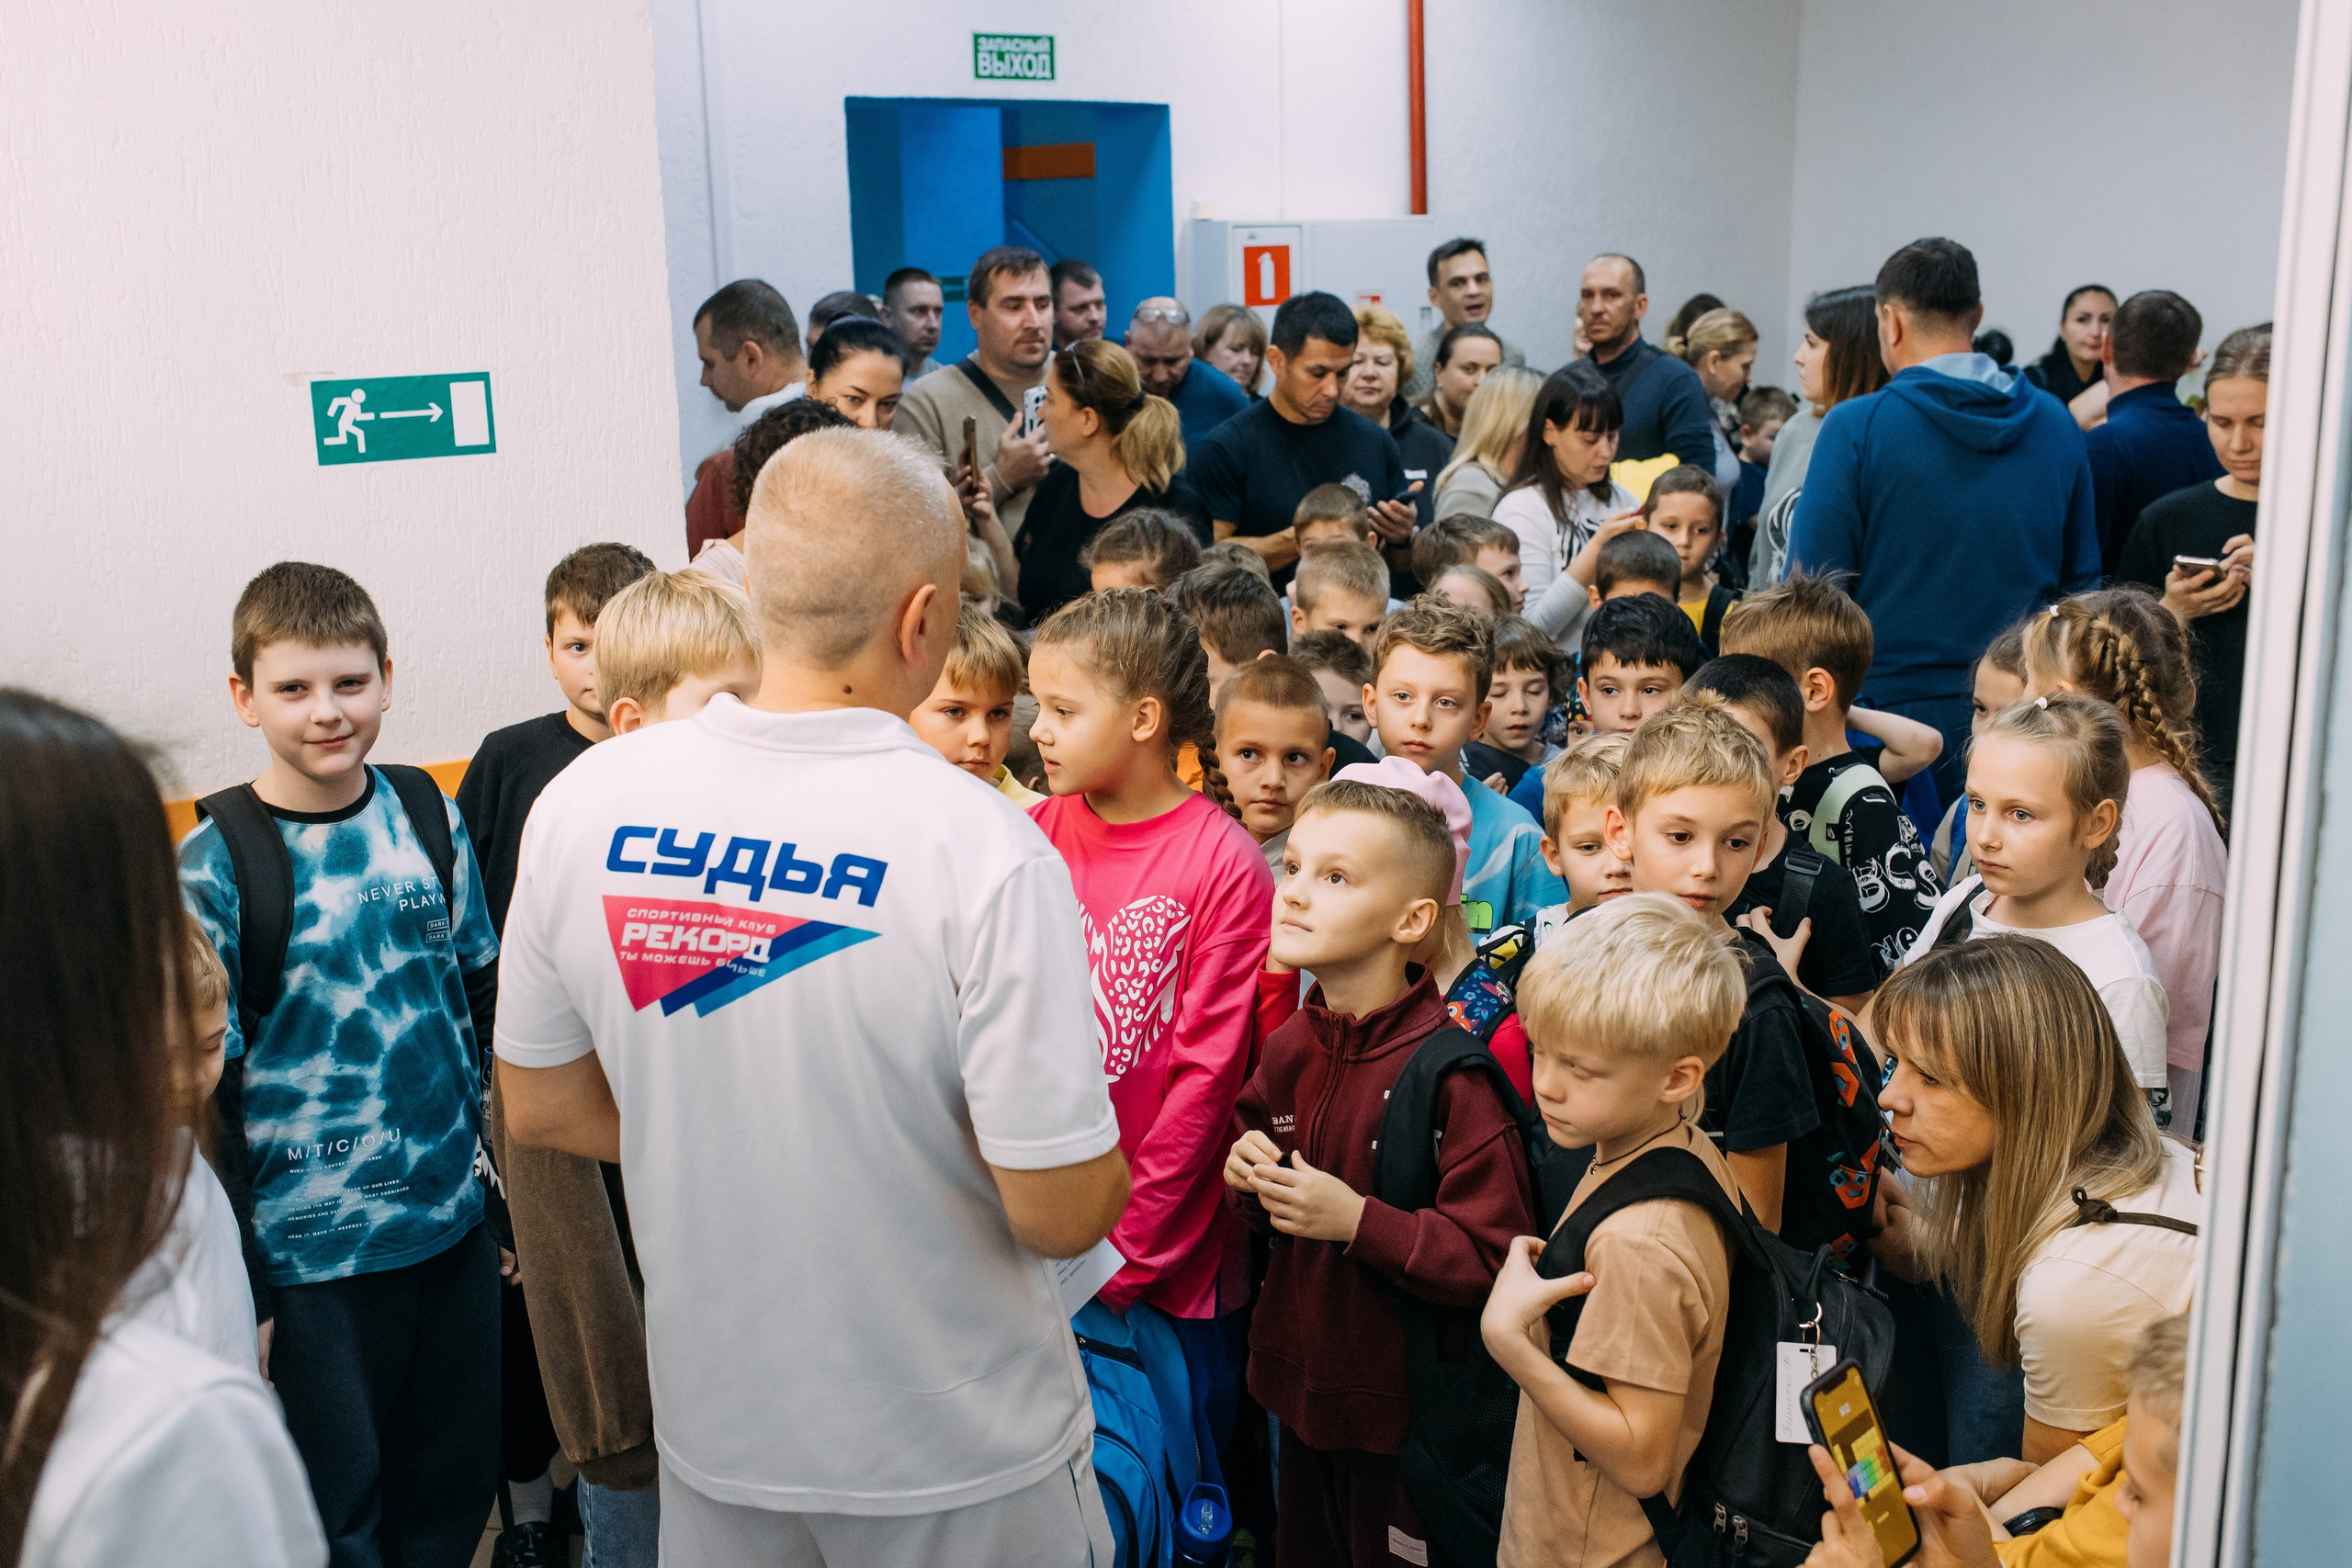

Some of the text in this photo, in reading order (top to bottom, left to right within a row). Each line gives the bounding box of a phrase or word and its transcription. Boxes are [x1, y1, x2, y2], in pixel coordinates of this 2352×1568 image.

[978, 36, 1050, 52] ЗАПАСНЫЙ
[978, 51, 1052, 78] ВЫХОД
[606, 825, 888, 908] СУДЬЯ
[358, 881, 416, 904] NEVER
[627, 908, 777, 935] СПОРТИВНЫЙ КЛУБ
[621, 922, 773, 964] РЕКОРД
[619, 951, 639, 961] ТЫ
[641, 953, 711, 966] МОЖЕШЬ
[324, 1161, 345, 1169] CENTER
[337, 1223, 363, 1231] RESPECT
